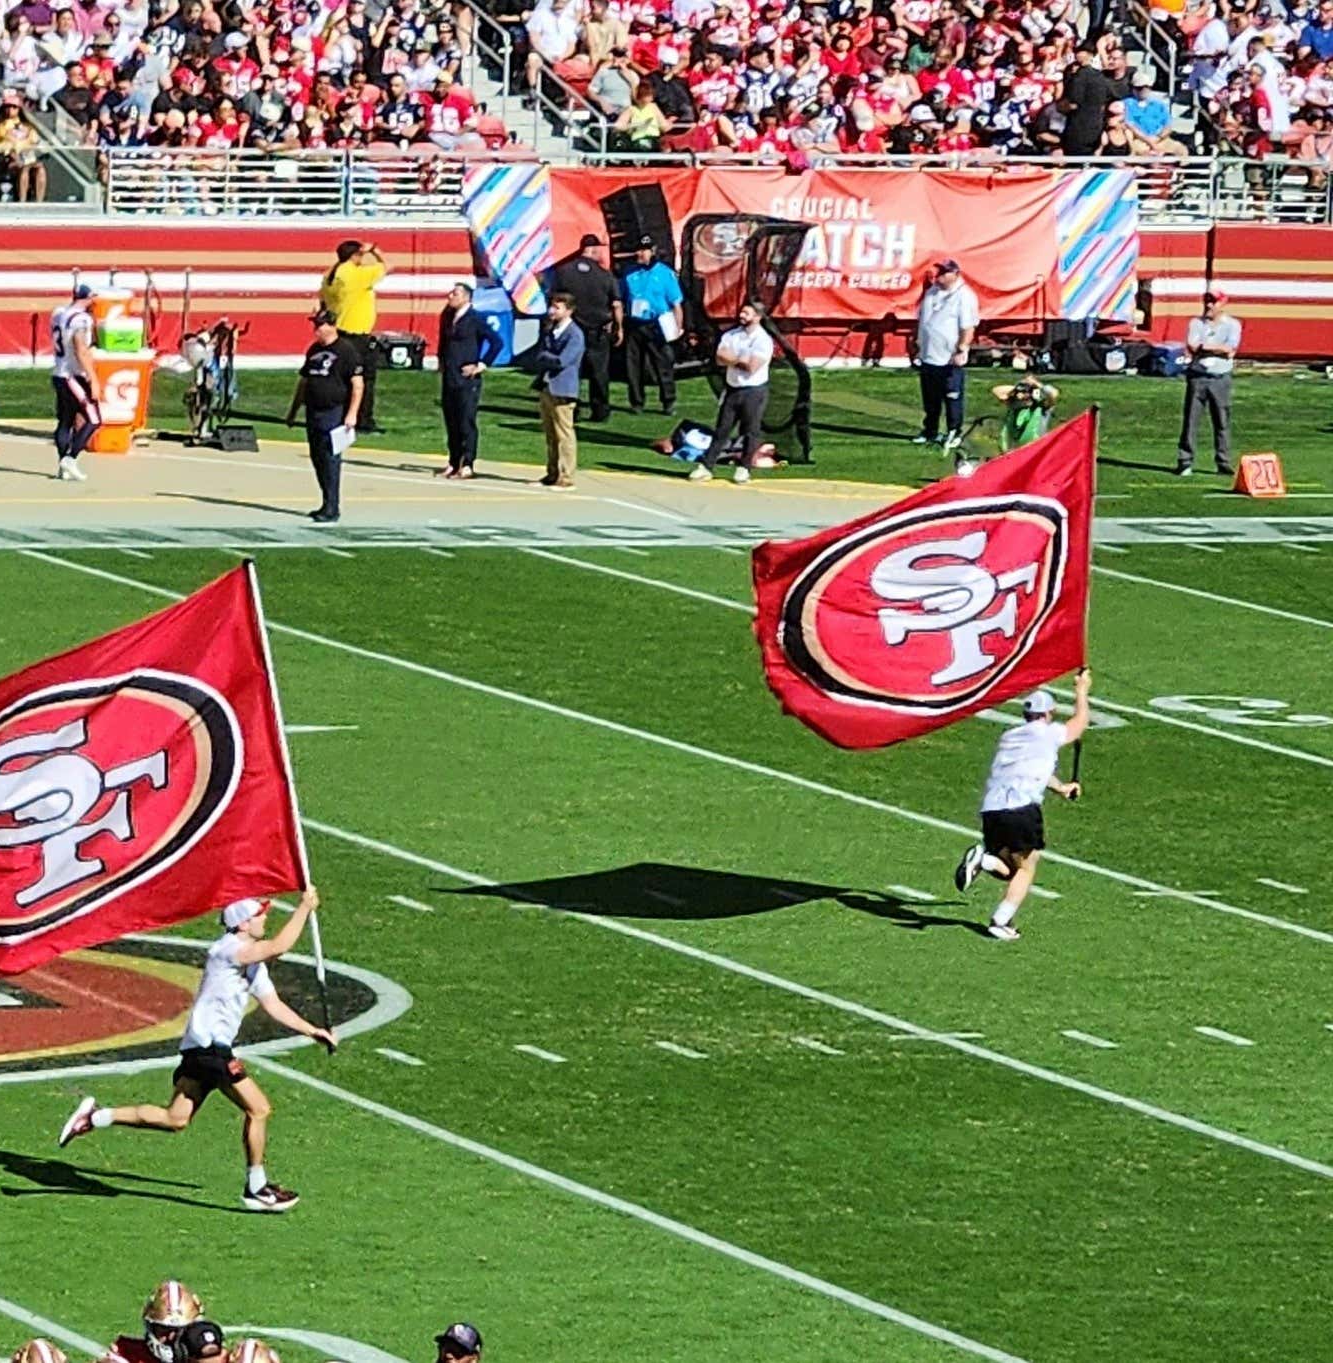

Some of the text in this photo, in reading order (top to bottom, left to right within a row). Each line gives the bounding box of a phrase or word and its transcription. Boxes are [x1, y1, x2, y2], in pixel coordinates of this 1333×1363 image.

[770, 197, 874, 220] CRUCIAL
[1250, 458, 1280, 491] 20
[869, 530, 1039, 687] SF
